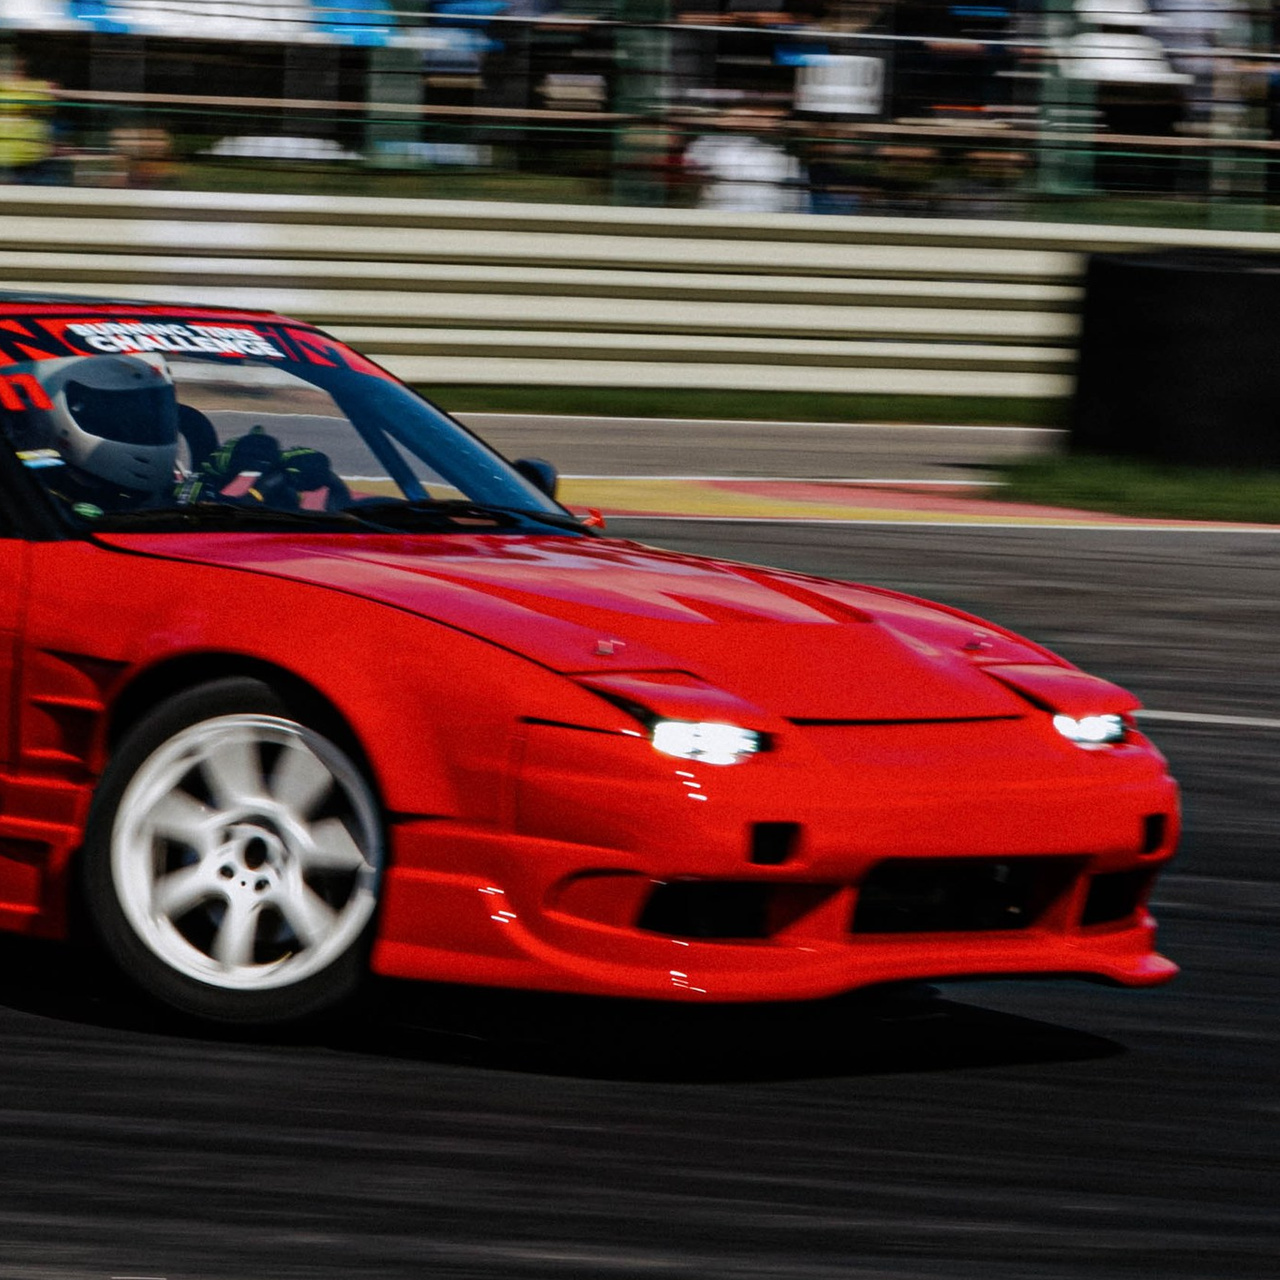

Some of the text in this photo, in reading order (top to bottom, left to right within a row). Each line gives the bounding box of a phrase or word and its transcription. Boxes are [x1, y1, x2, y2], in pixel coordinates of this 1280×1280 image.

[65, 323, 267, 342] BURNING TIRES
[85, 334, 287, 358] CHALLENGE
